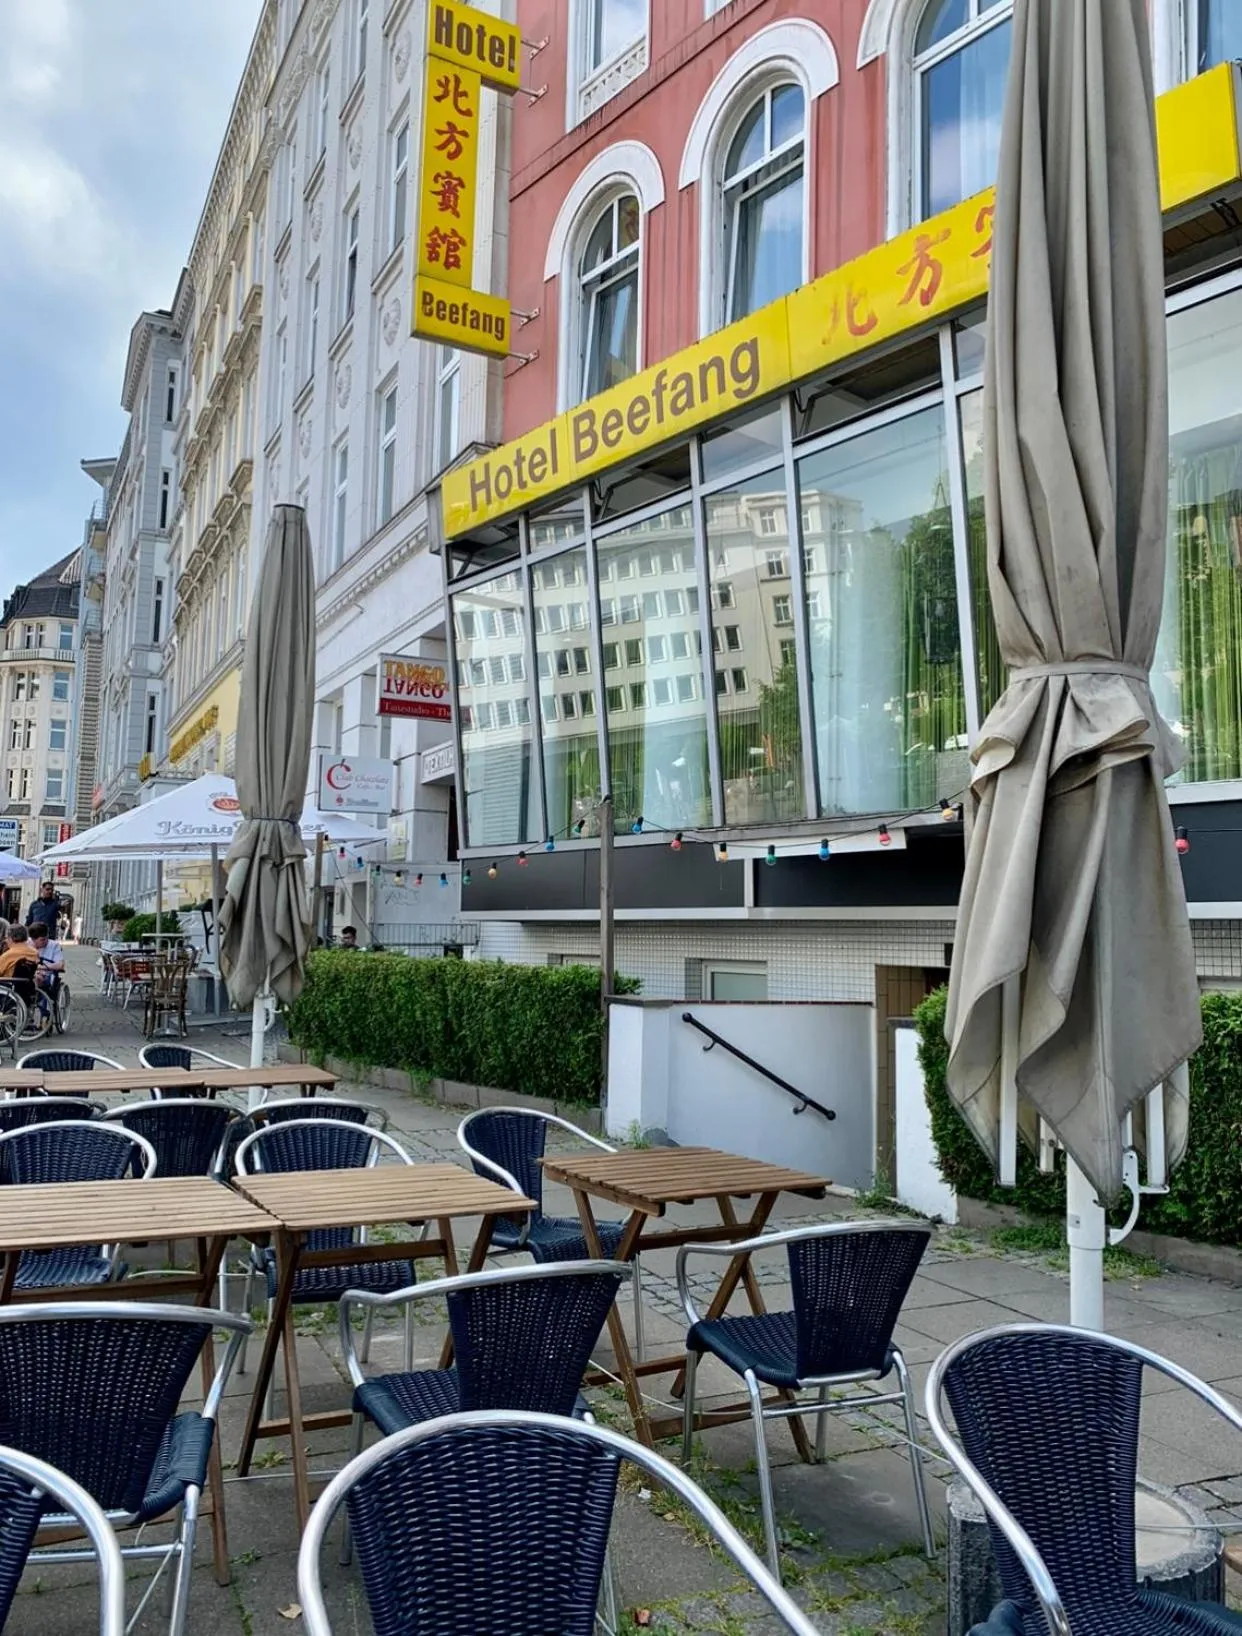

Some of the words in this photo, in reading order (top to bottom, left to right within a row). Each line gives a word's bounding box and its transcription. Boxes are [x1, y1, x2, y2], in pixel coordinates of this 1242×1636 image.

[434, 5, 517, 74] Hotel
[426, 73, 473, 271] 北方賓館
[421, 291, 506, 341] Beefang
[469, 430, 559, 513] Hotel
[572, 336, 761, 463] Beefang
[154, 820, 233, 837] König
